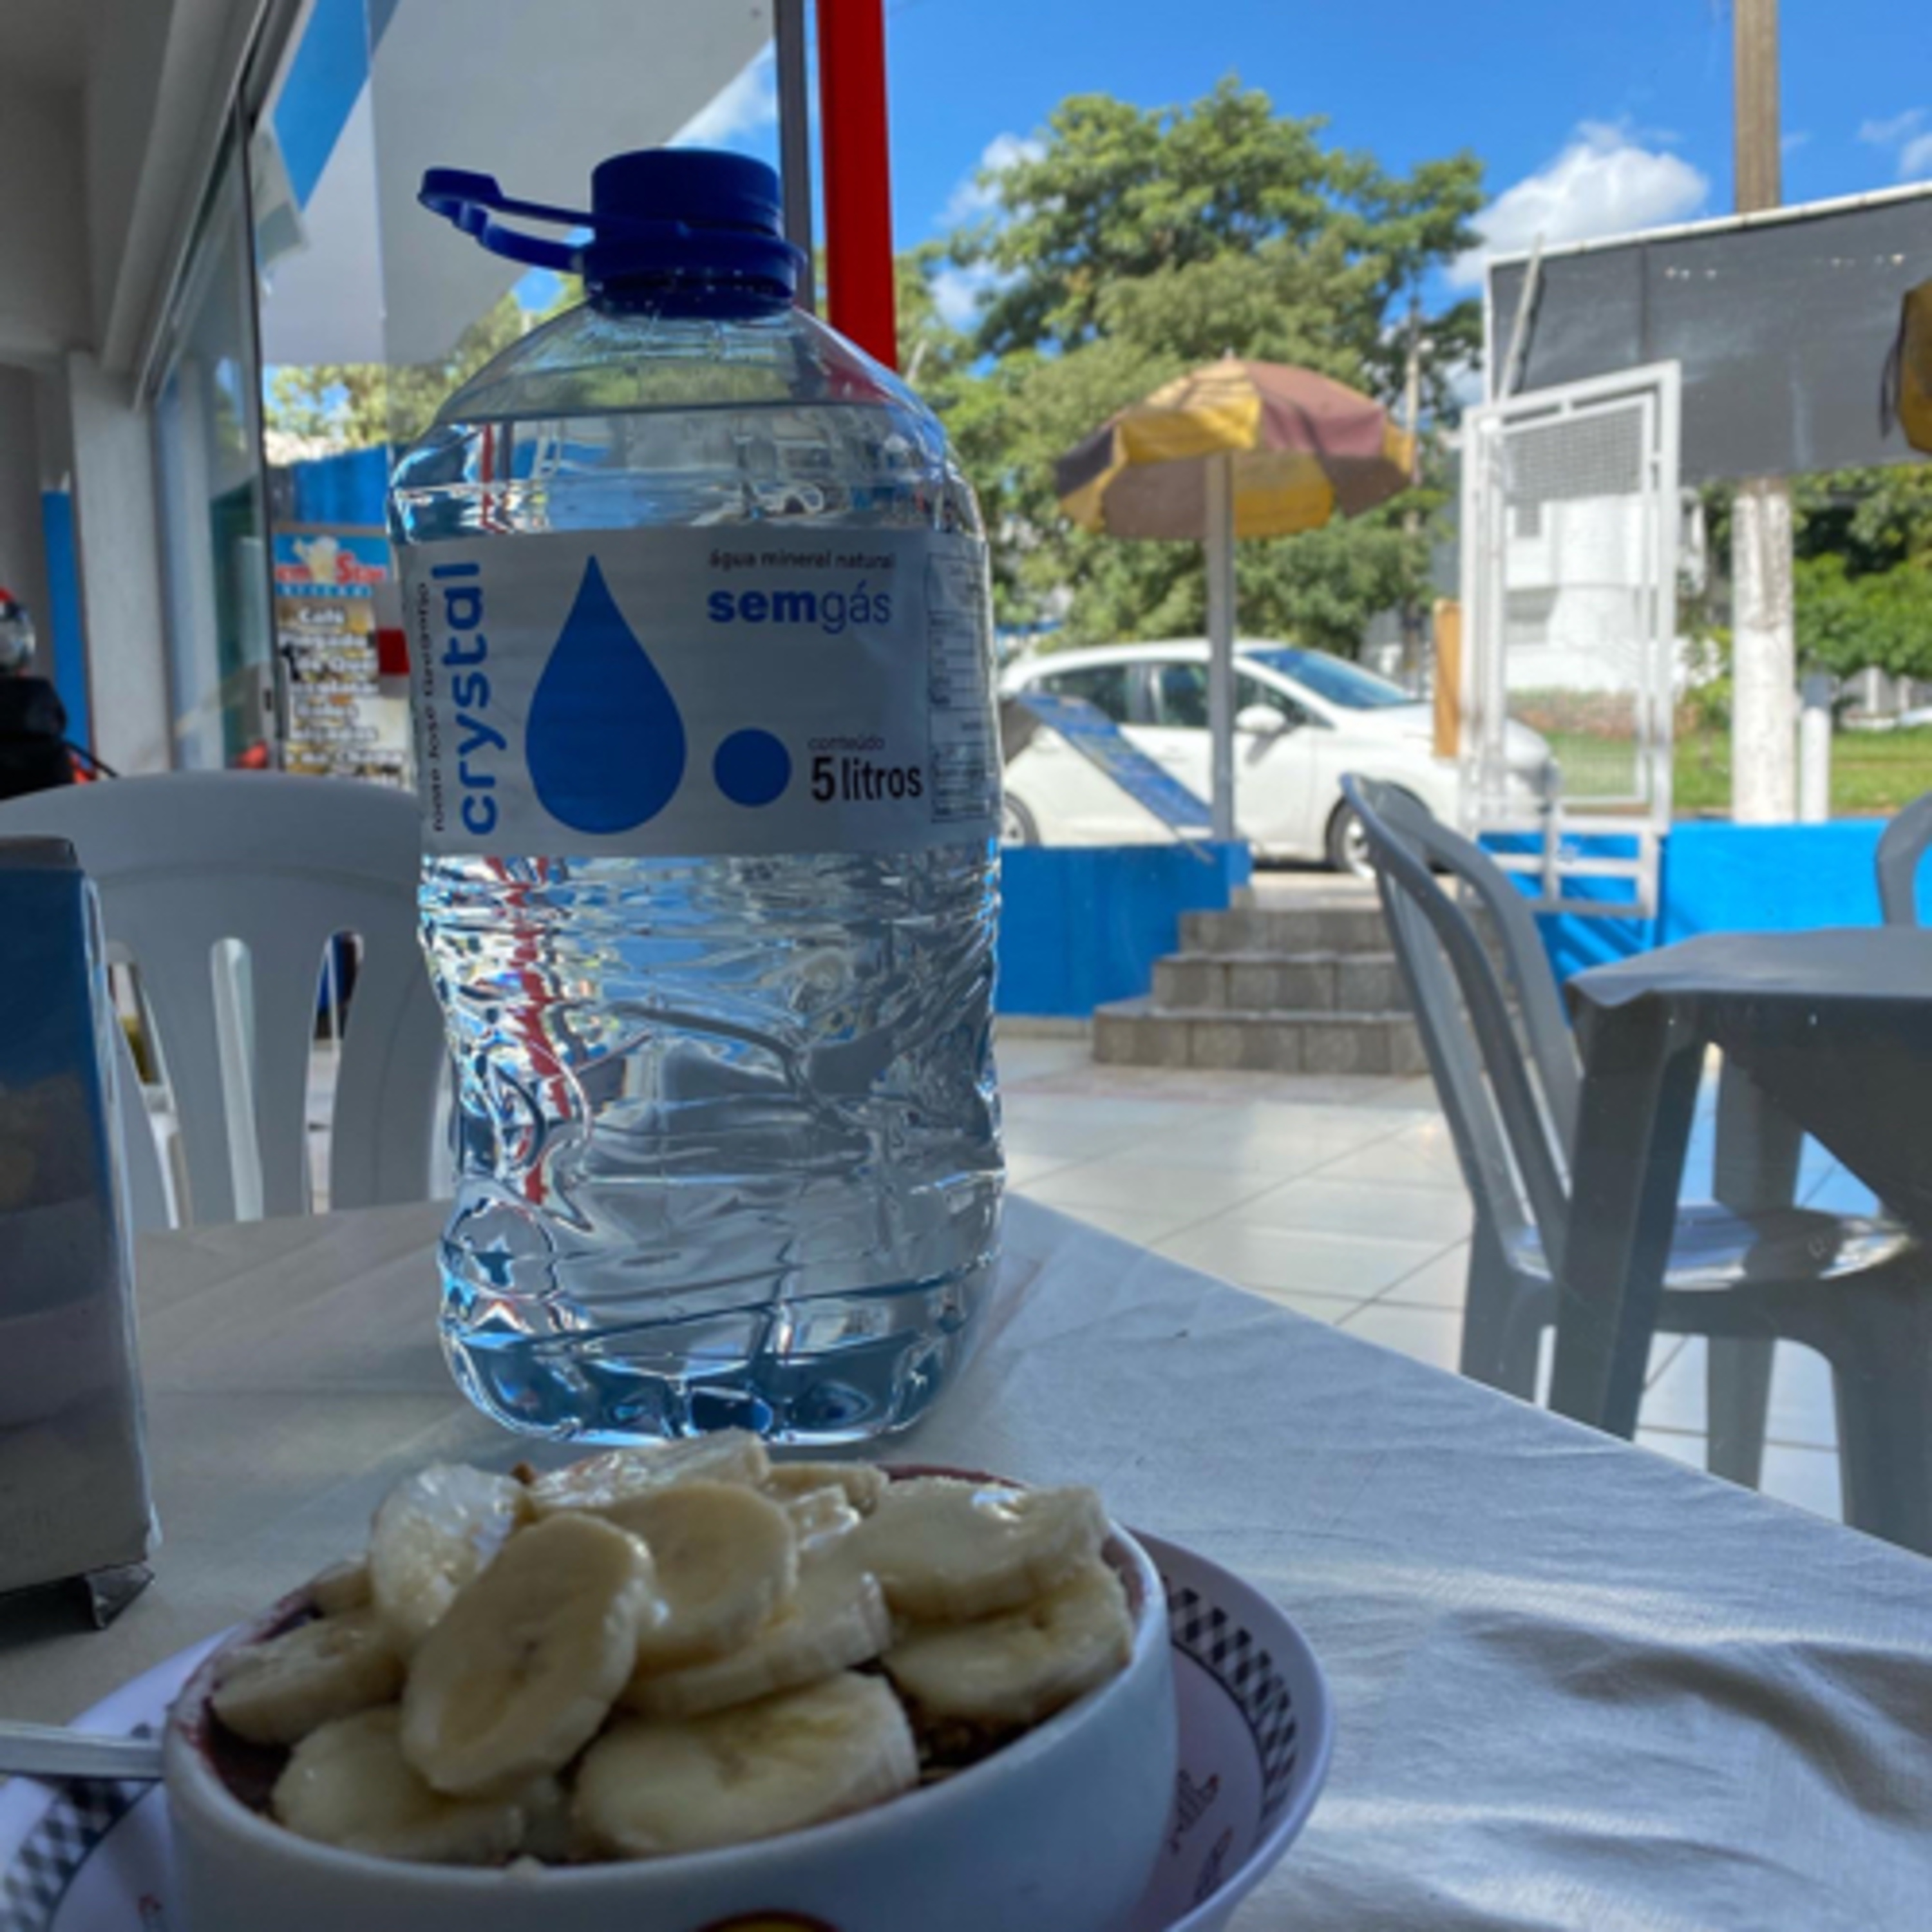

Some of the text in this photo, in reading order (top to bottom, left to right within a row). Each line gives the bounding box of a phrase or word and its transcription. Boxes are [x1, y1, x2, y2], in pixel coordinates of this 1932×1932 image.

[709, 548, 896, 571] água mineral natural
[431, 563, 507, 835] crystal
[808, 735, 885, 752] conteúdo
[810, 756, 837, 803] 5
[842, 757, 923, 801] litros
